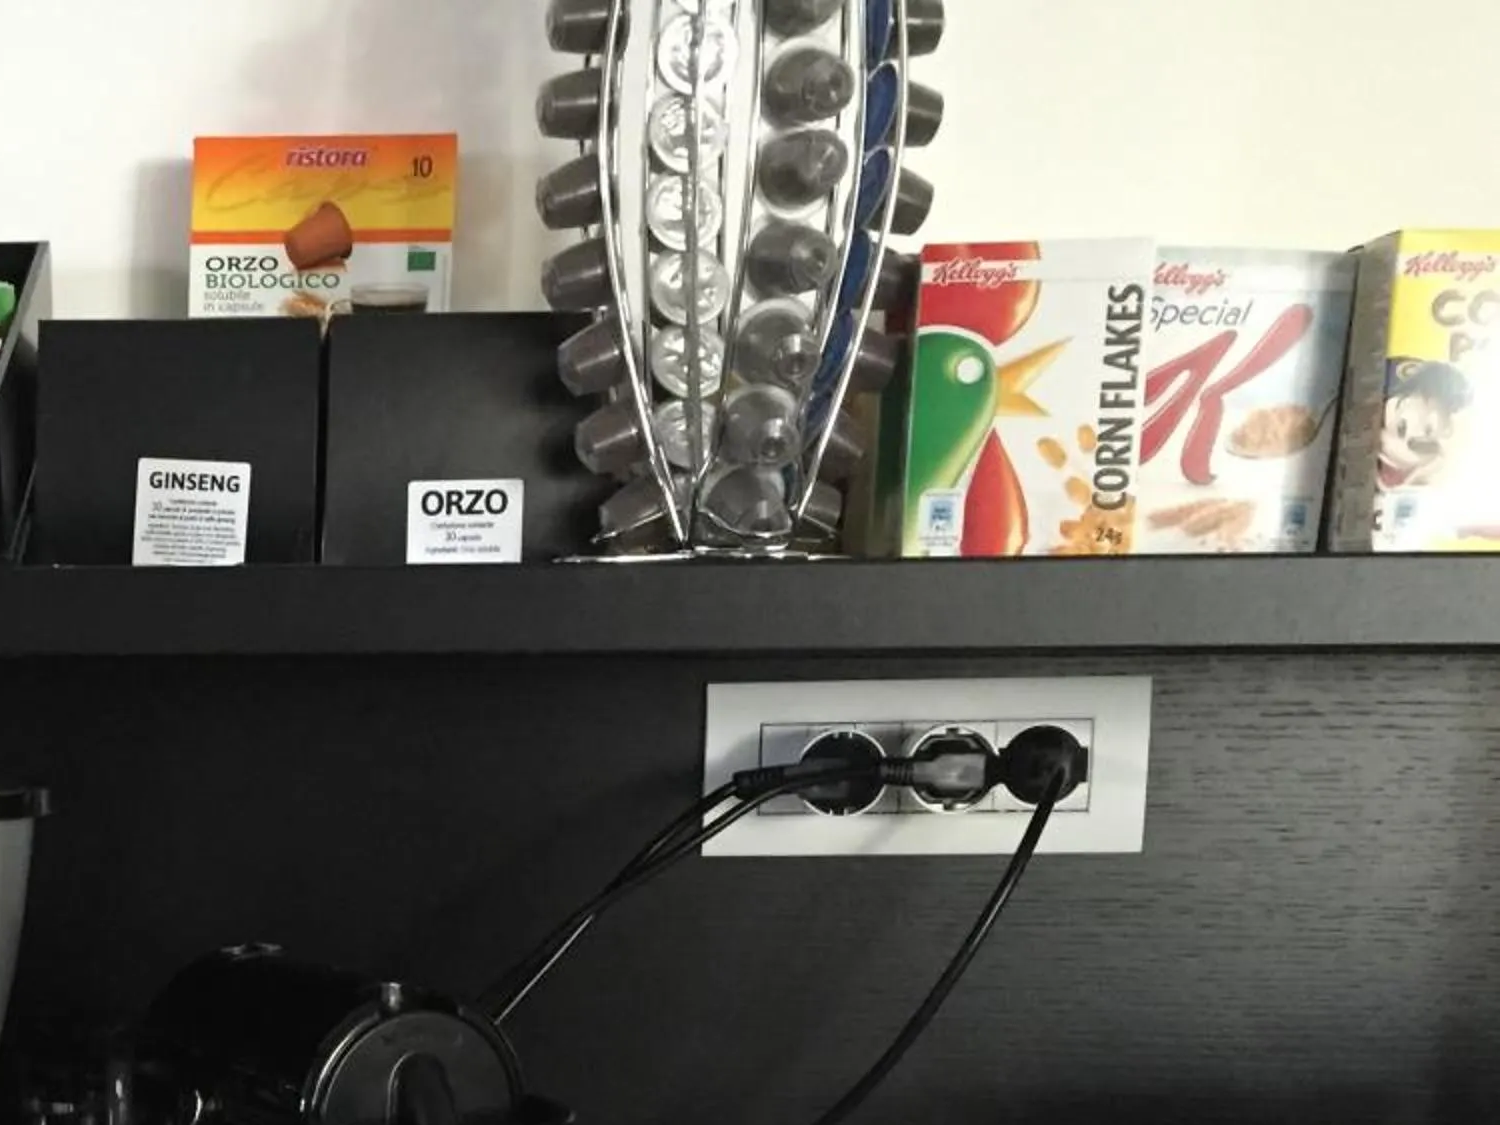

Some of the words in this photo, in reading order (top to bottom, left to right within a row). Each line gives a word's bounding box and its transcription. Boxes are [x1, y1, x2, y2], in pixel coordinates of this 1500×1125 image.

[286, 147, 367, 168] ristora
[412, 156, 433, 178] 10
[205, 255, 279, 273] ORZO
[205, 272, 341, 290] BIOLOGICO
[1099, 283, 1145, 409] FLAKES
[1091, 416, 1135, 512] CORN
[149, 471, 241, 493] GINSENG
[421, 488, 509, 516] ORZO
